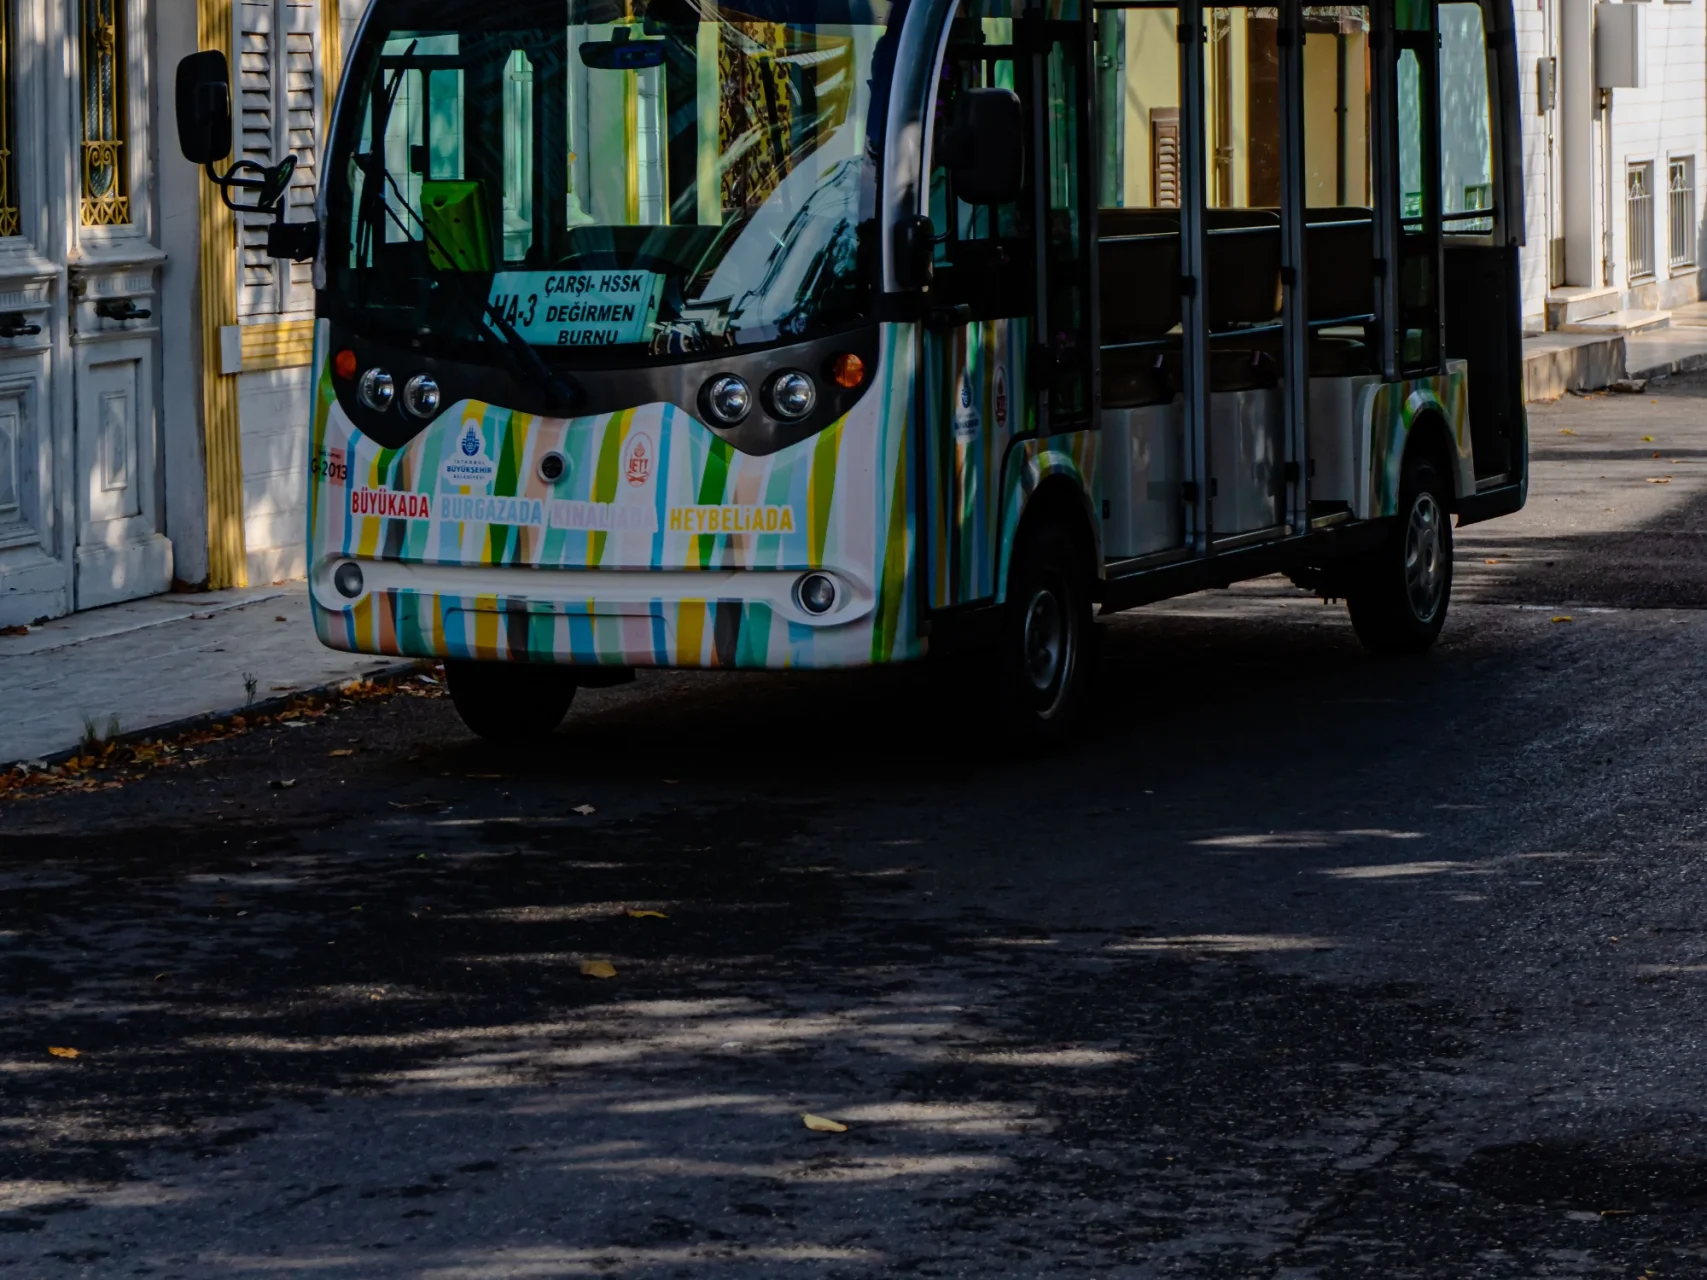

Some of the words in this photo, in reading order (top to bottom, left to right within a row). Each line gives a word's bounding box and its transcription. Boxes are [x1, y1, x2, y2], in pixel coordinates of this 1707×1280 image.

[545, 275, 595, 297] ÇARŞI-
[599, 274, 643, 293] HSSK
[490, 293, 538, 328] HA-3
[545, 300, 635, 323] DEĞİRMEN
[557, 329, 619, 345] BURNU
[311, 458, 348, 480] G-2013
[446, 465, 492, 474] BÜYÜKŞEHİR
[352, 486, 429, 518] BÜYÜKADA
[442, 497, 543, 525] BURGAZADA
[553, 501, 658, 530] KINALIADA
